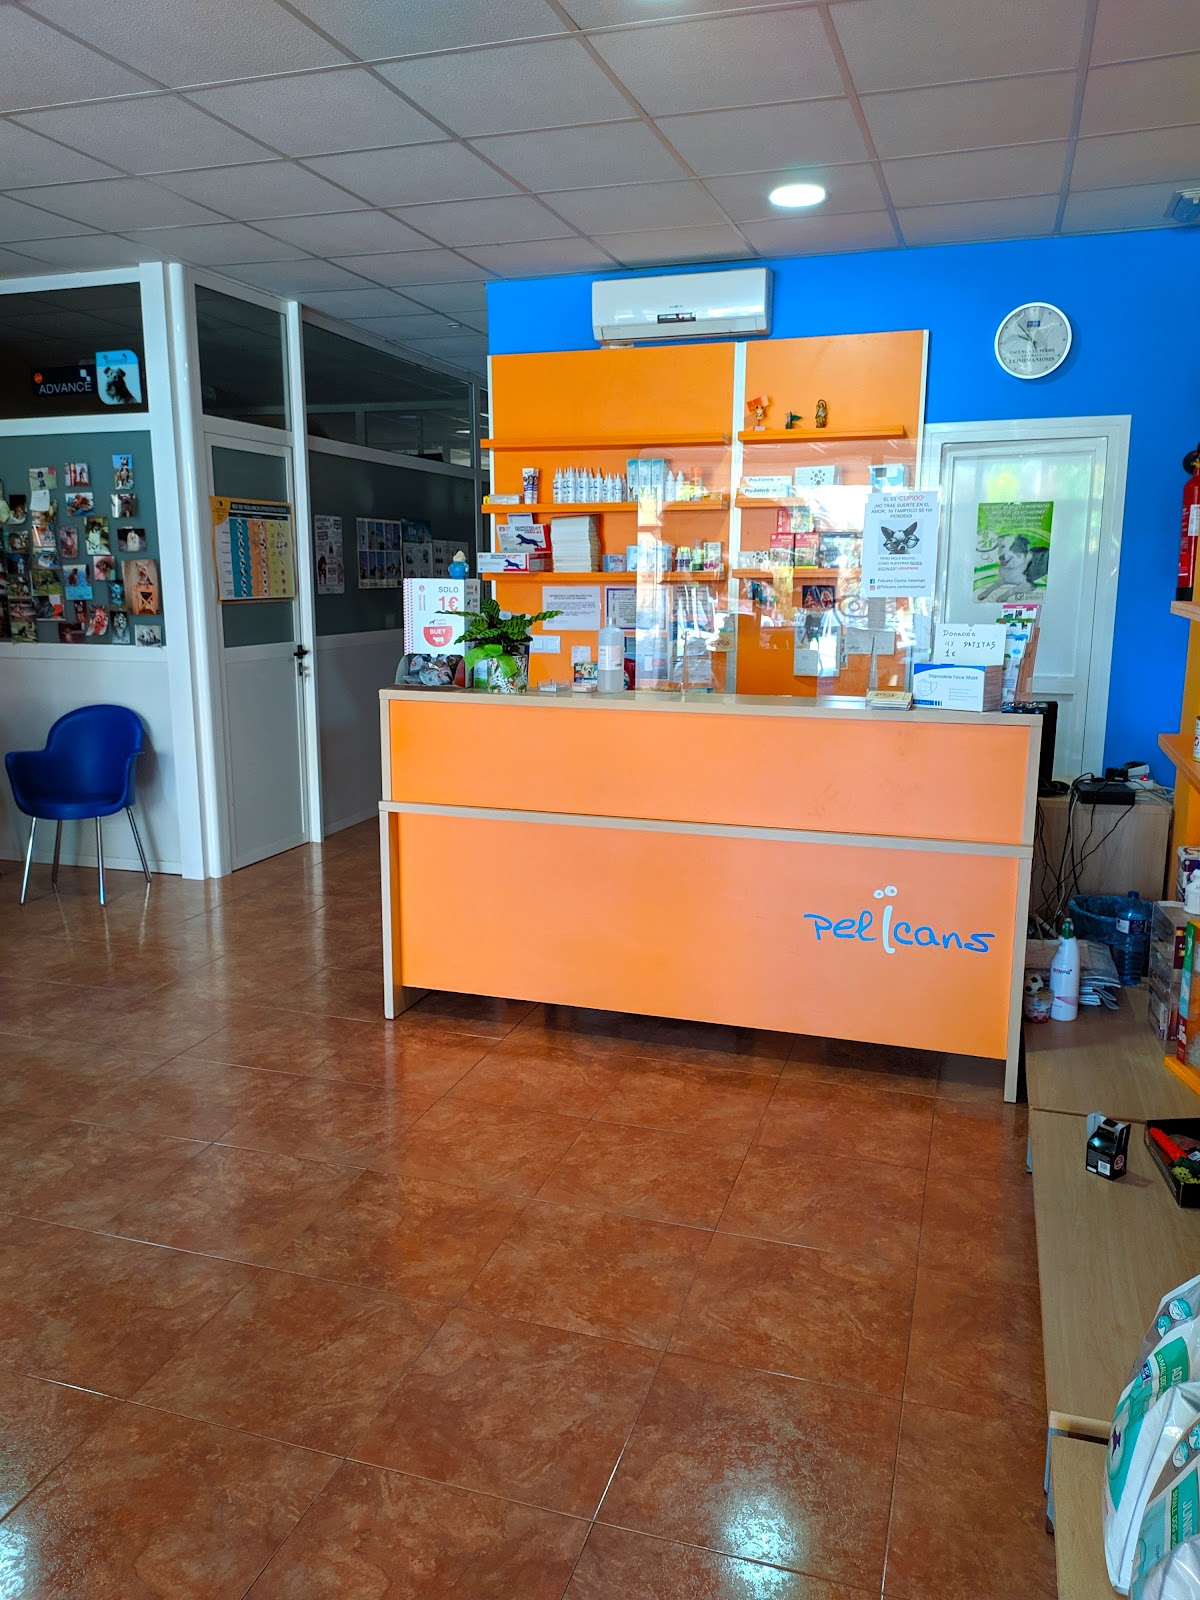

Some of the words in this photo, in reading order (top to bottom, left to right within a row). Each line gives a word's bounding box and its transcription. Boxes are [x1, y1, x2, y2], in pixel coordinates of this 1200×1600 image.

[39, 382, 92, 394] ADVANCE
[438, 596, 459, 611] 1€
[943, 629, 976, 637] Donación
[963, 641, 996, 650] PATITAS
[1157, 1354, 1166, 1376] SMALL
[1171, 1366, 1182, 1386] ADU
[1182, 1500, 1193, 1541] JUNIO
